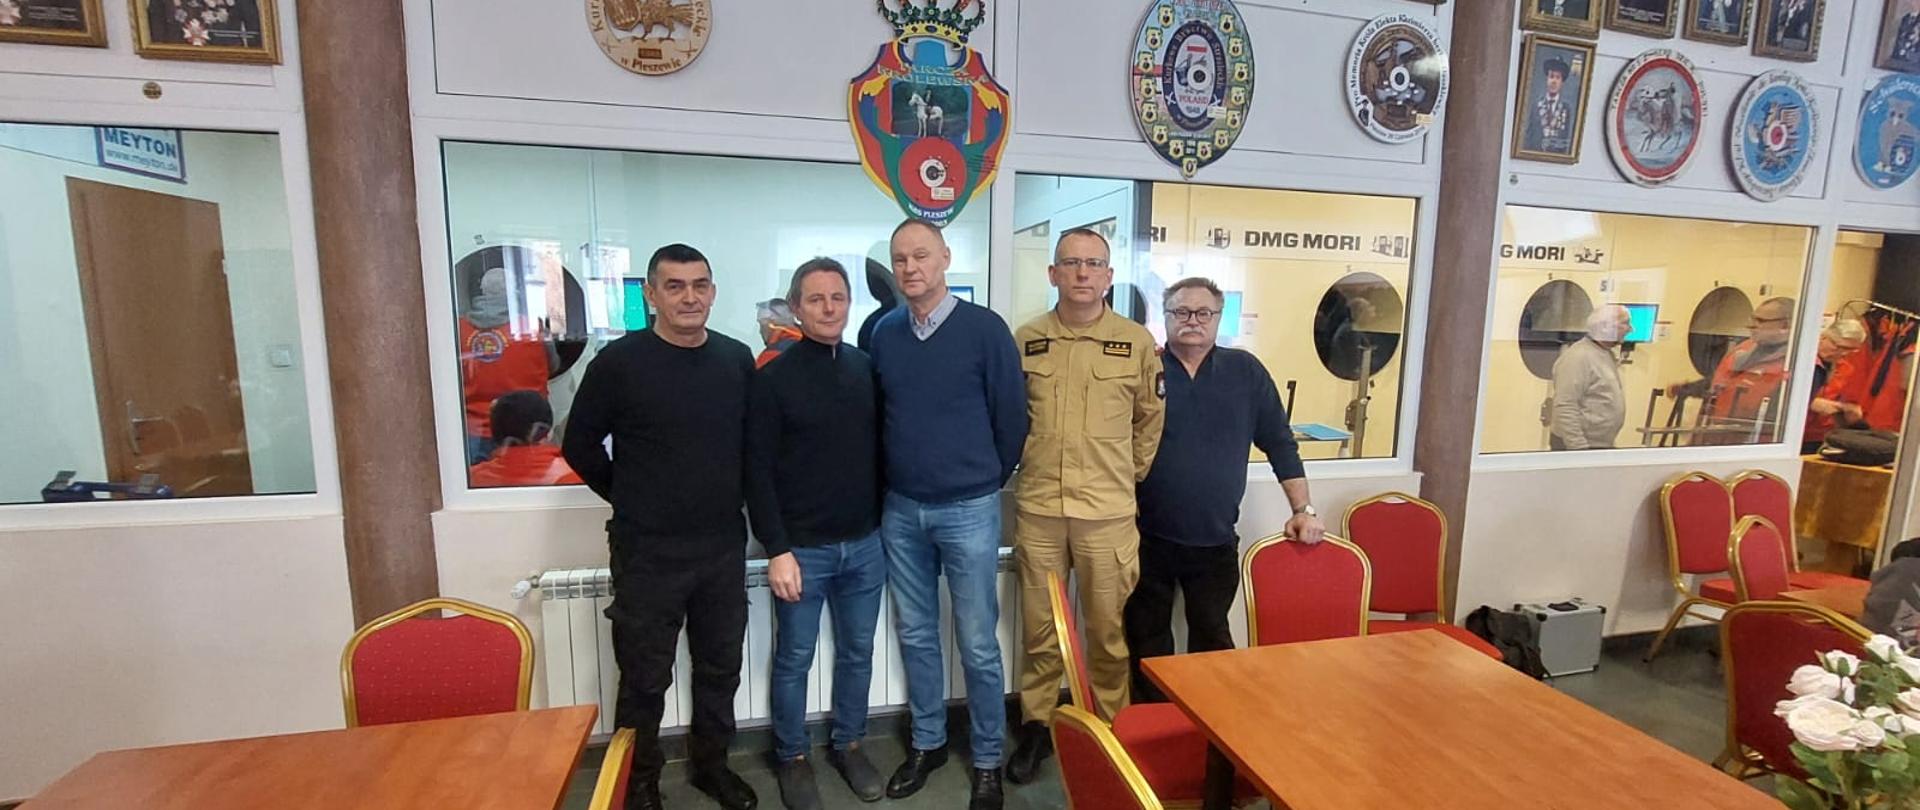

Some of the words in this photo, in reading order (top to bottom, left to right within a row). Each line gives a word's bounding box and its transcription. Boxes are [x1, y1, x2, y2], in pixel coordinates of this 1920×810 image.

[104, 127, 177, 158] MEYTON
[1244, 230, 1298, 248] DMG
[1302, 233, 1360, 251] MORI
[1516, 245, 1565, 261] MORI
